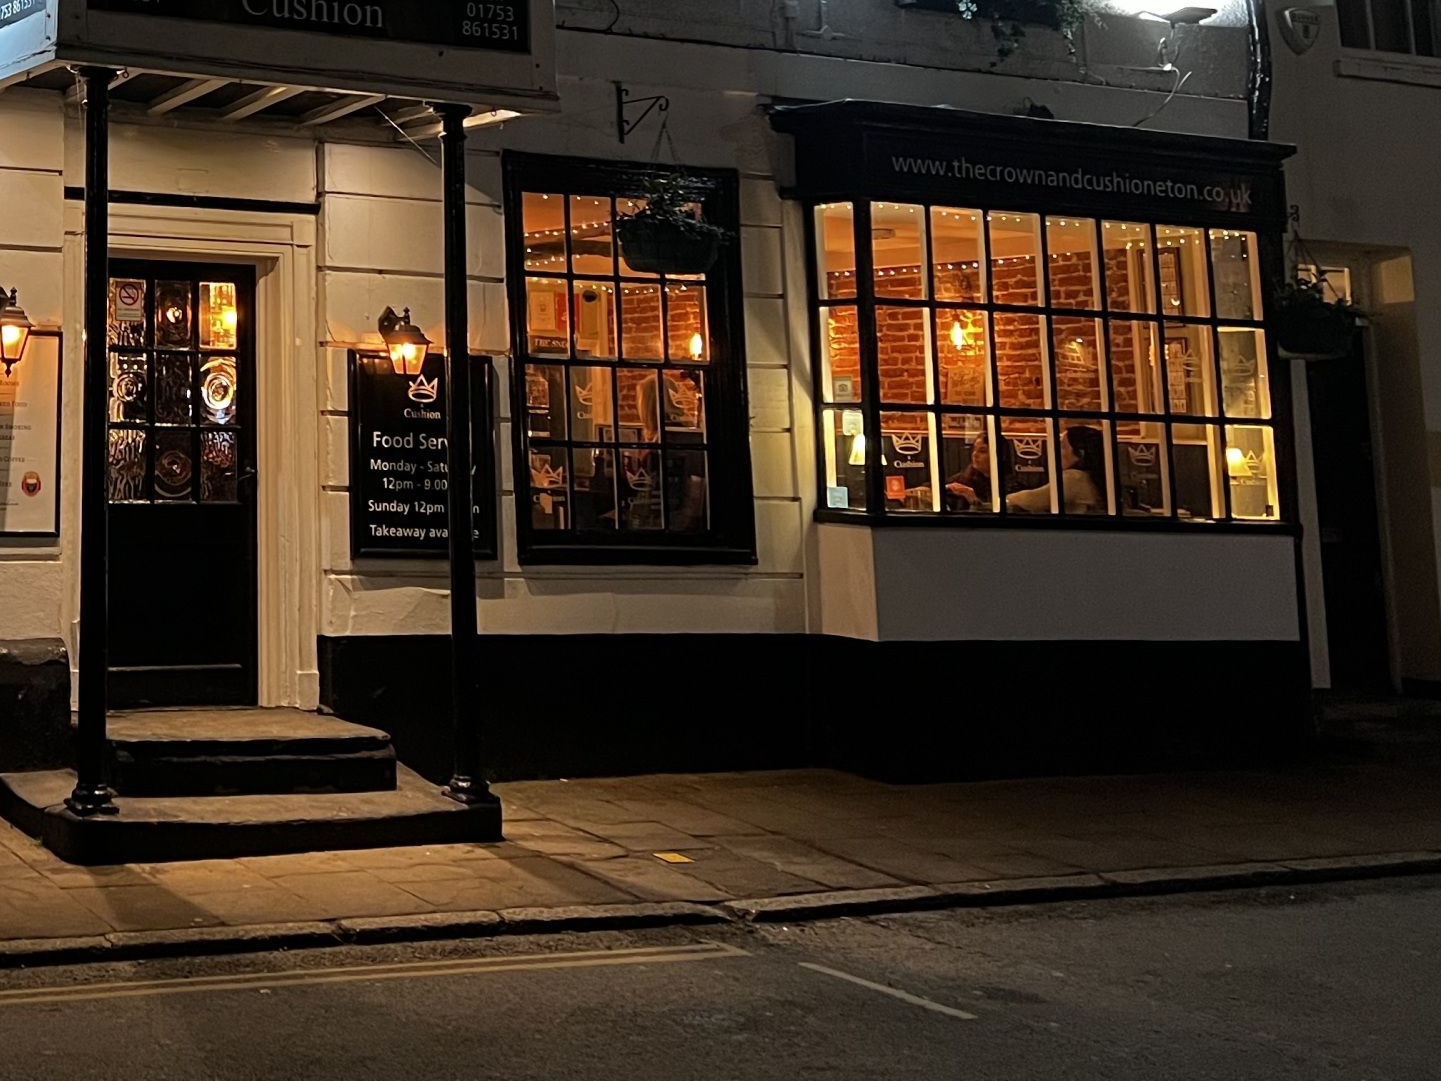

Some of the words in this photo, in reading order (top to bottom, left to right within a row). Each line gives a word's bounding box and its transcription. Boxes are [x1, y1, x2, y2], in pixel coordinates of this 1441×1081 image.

[466, 2, 515, 21] 01753
[461, 20, 518, 40] 861531
[892, 154, 1252, 205] www.thecrownandcushioneton.co.uk
[404, 408, 441, 419] Cushion
[372, 431, 414, 449] Food
[419, 433, 448, 450] Serv
[370, 459, 417, 475] Monday
[382, 477, 414, 491] 12pm
[368, 500, 410, 515] Sunday
[414, 501, 445, 515] 12pm
[369, 525, 426, 540] Takeaway
